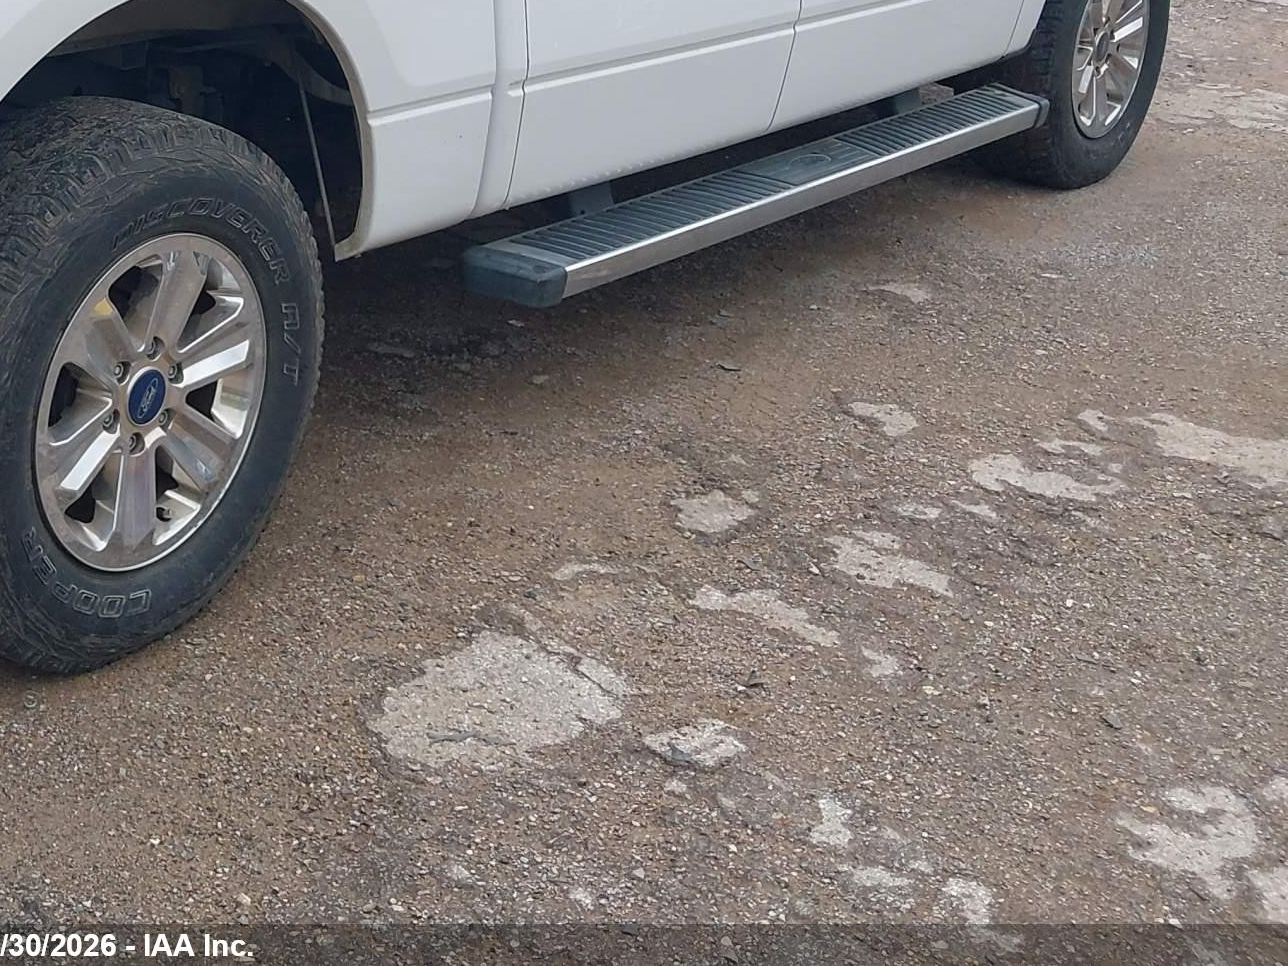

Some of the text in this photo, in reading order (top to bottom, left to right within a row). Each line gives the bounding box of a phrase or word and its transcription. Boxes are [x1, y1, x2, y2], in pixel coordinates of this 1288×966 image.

[112, 197, 303, 386] DISCOVERER A/T
[20, 526, 152, 618] COOPER
